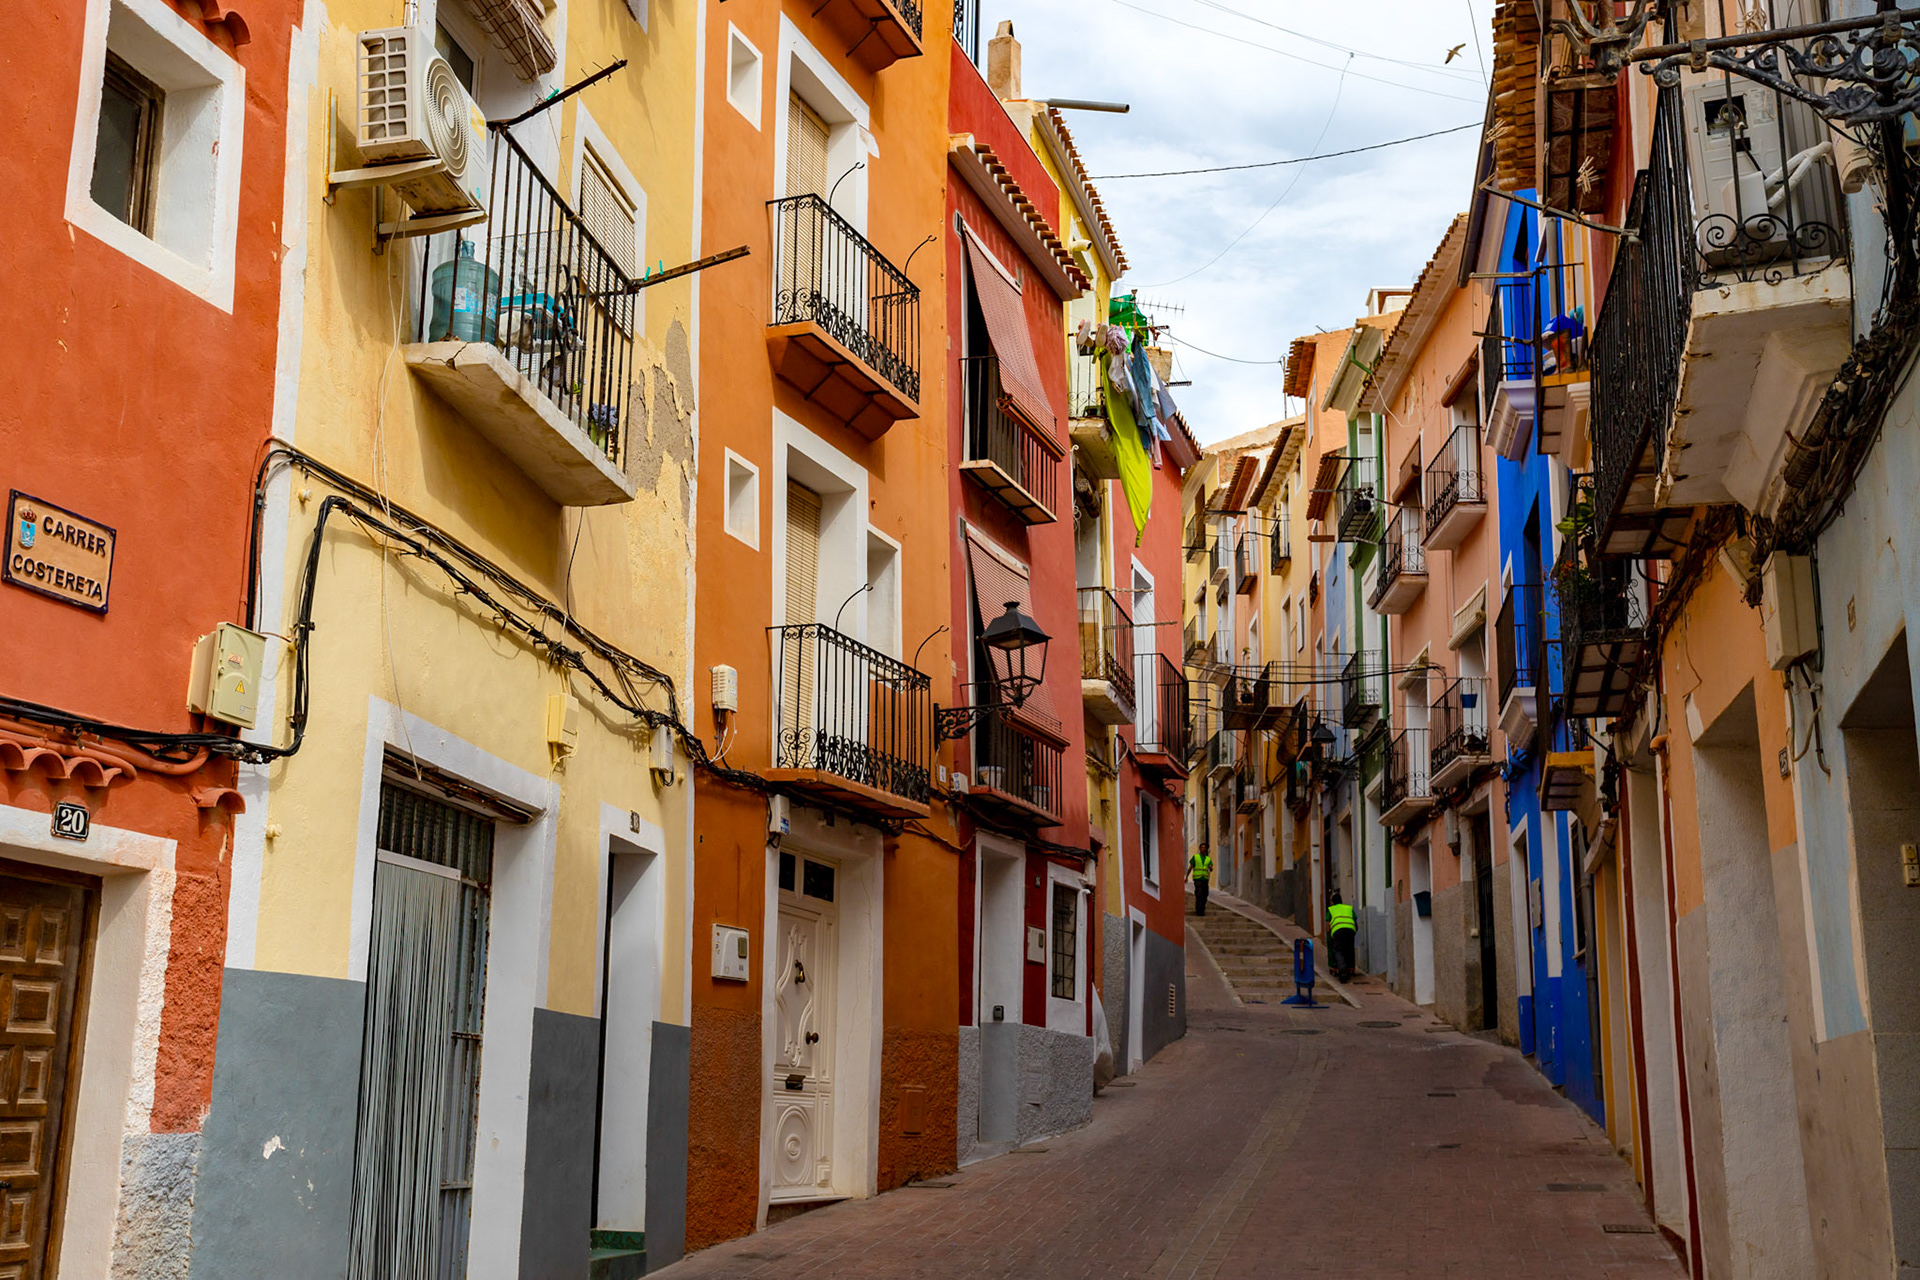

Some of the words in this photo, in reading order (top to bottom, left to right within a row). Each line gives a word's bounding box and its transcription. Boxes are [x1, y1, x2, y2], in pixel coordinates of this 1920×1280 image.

[43, 516, 106, 557] CARRER
[13, 554, 103, 601] COSTERETA
[60, 808, 85, 833] 20
